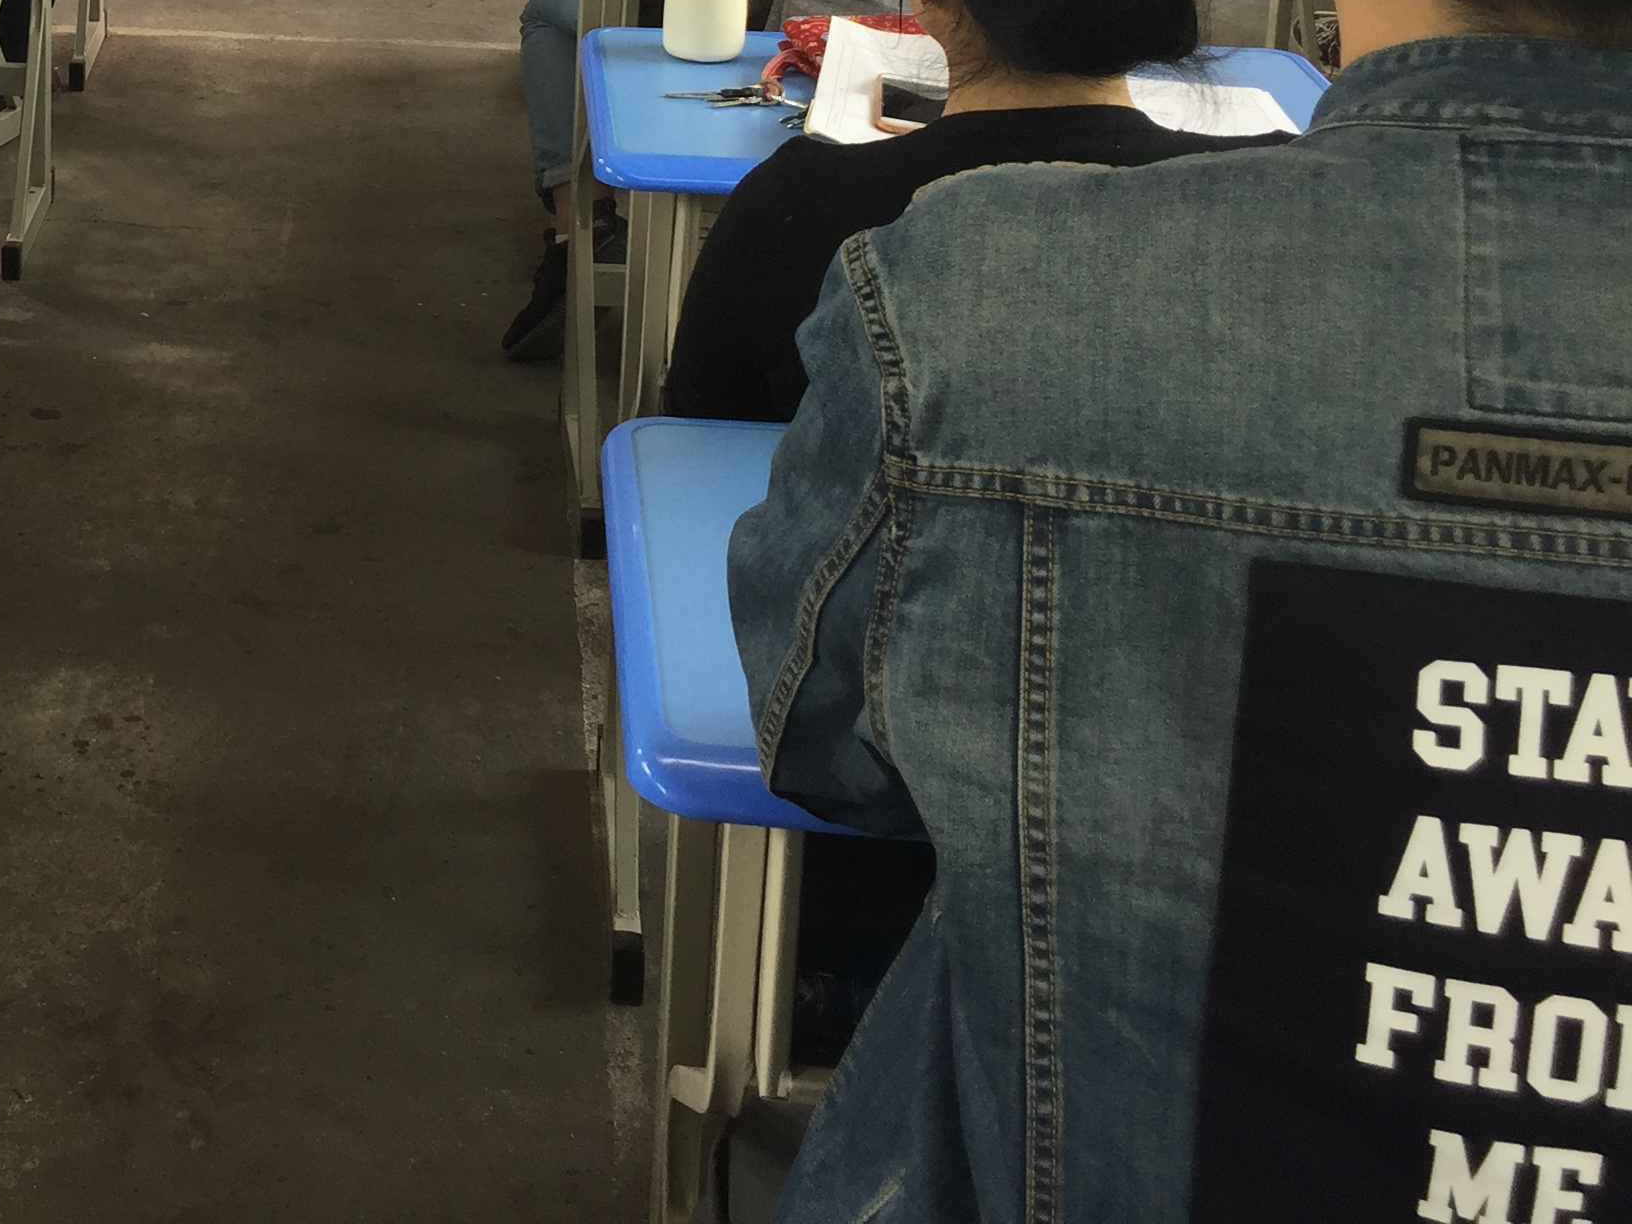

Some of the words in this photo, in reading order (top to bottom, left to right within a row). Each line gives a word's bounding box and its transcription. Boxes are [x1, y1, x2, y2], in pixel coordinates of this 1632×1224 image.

[1429, 444, 1632, 496] PANMAX-
[1412, 659, 1632, 789] STA
[1355, 961, 1632, 1112] FRO
[1416, 1128, 1604, 1224] ME
